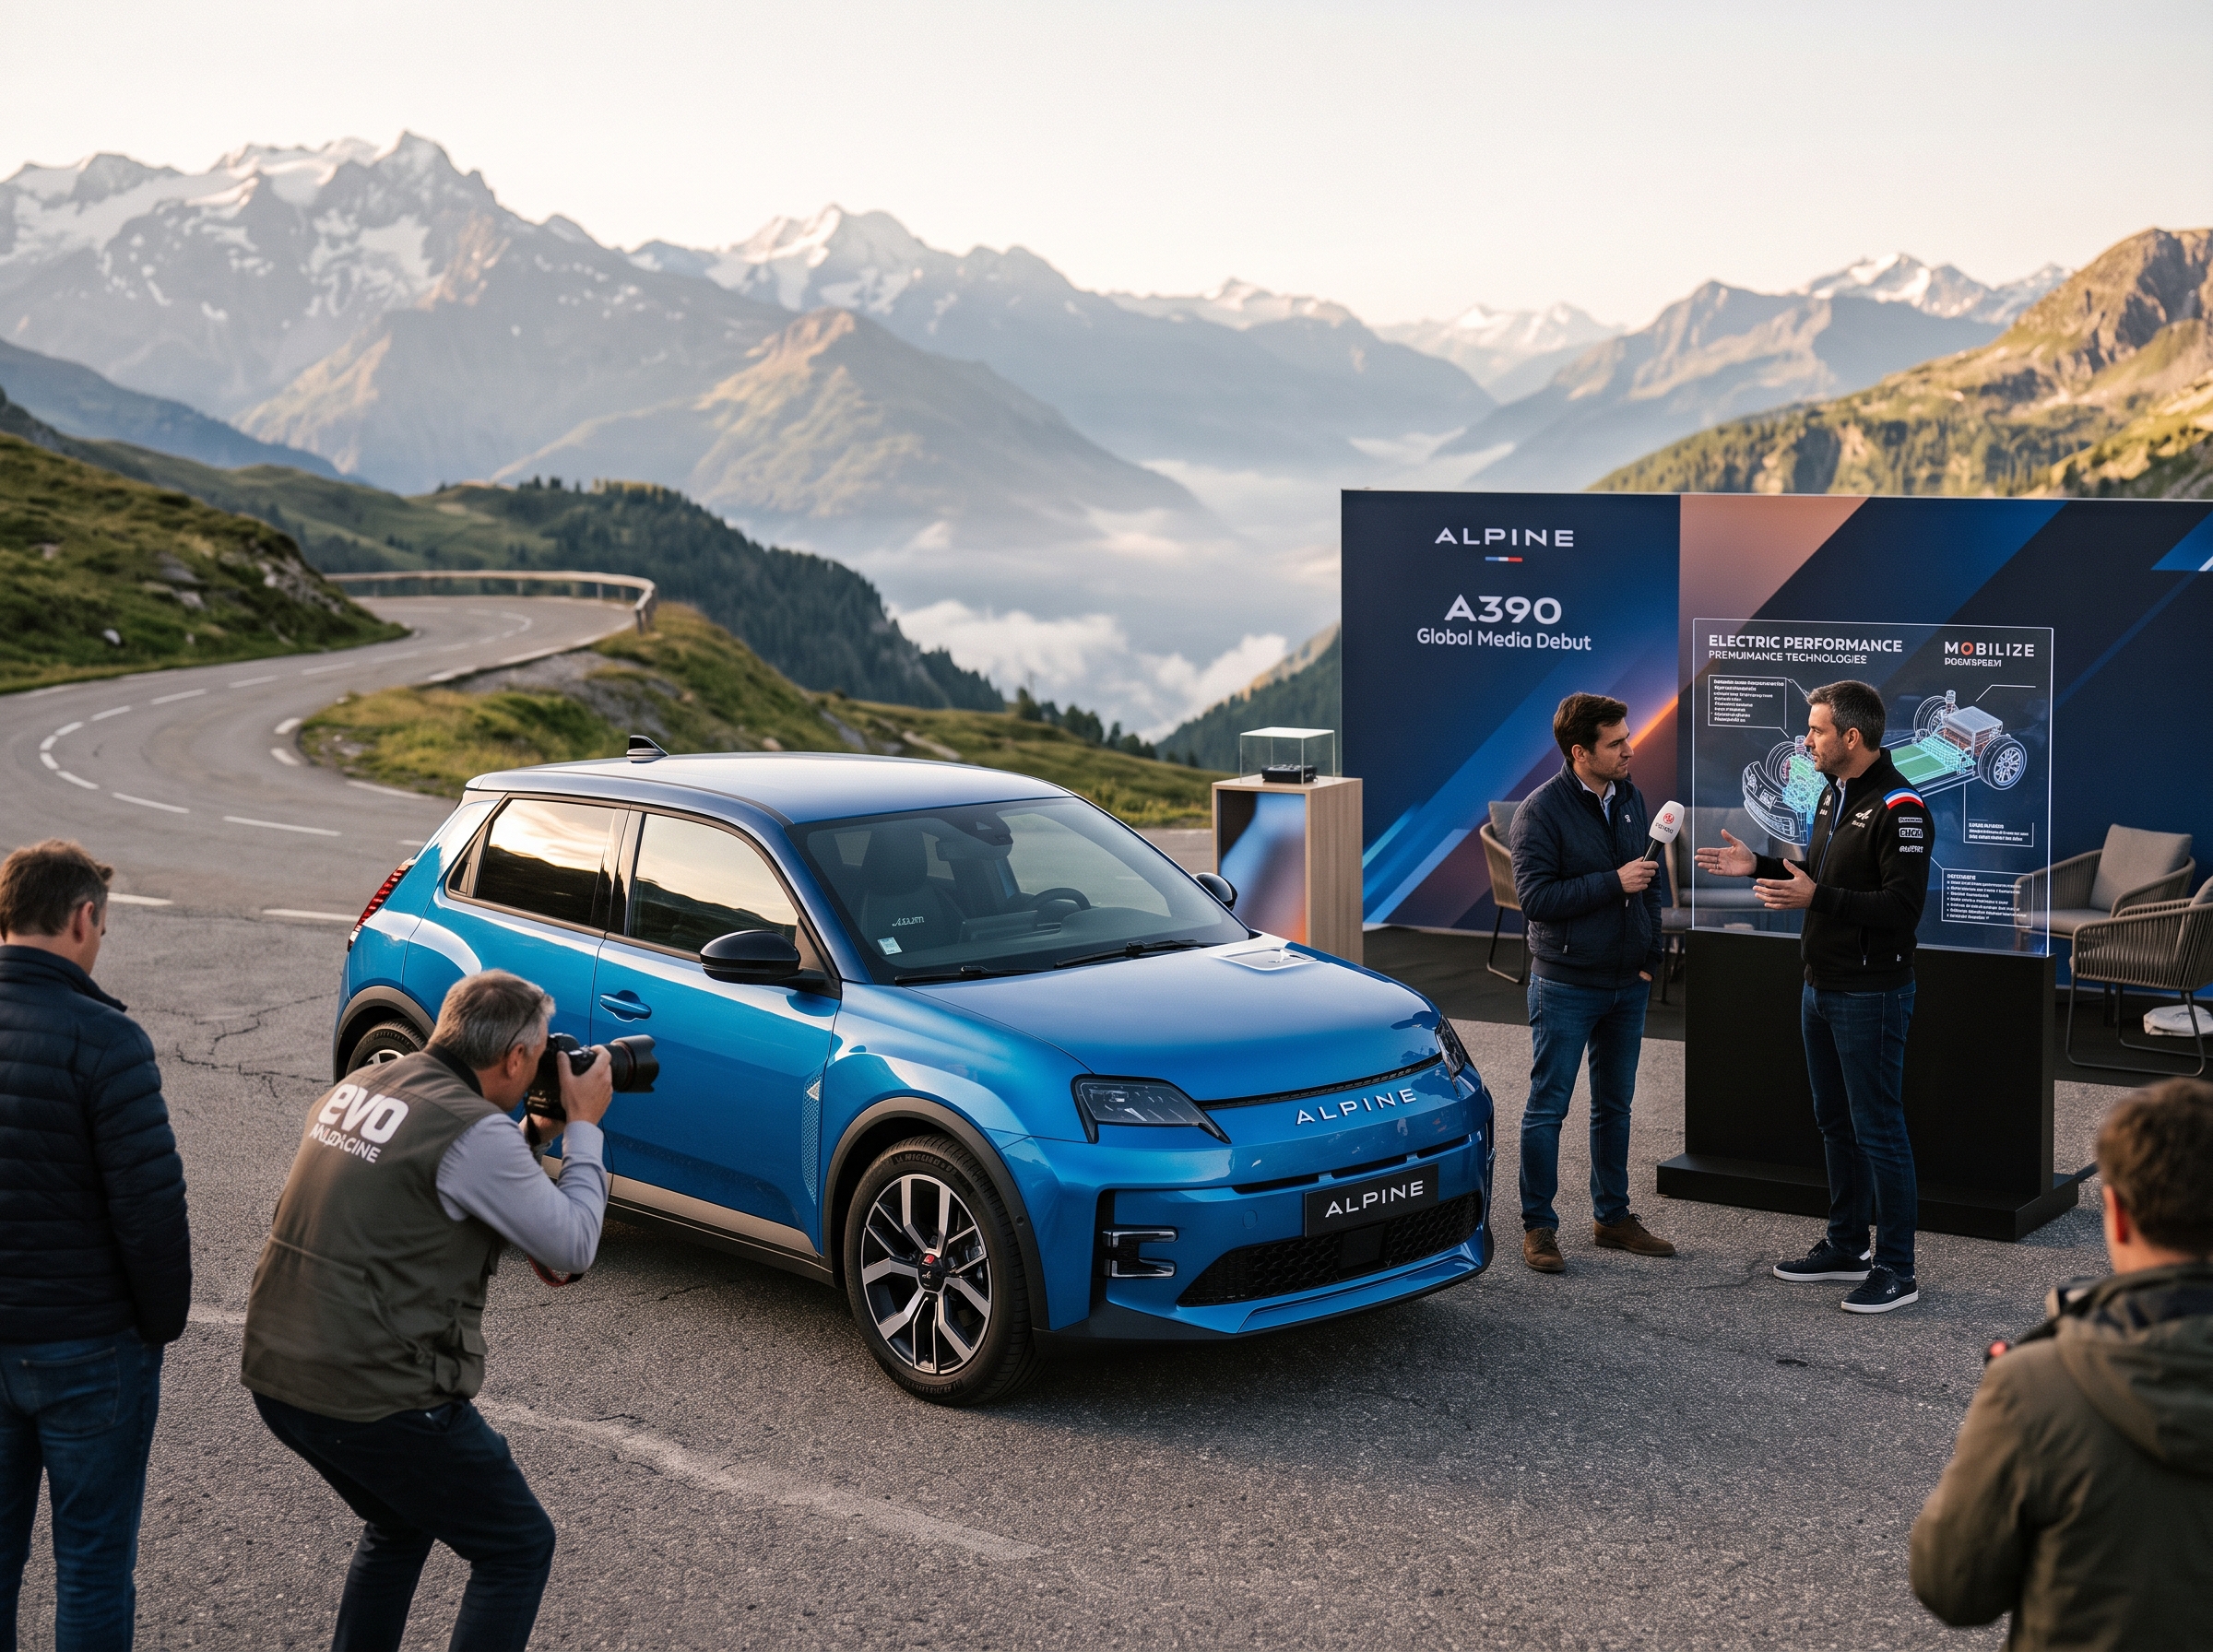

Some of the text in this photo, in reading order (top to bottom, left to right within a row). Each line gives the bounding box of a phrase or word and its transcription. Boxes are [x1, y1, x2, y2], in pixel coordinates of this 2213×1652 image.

[1435, 527, 1573, 547] ALPINE
[1445, 595, 1561, 624] A390
[1417, 628, 1592, 651] Global Media Debut
[1709, 634, 1903, 653] ELECTRIC PERFORMANCE
[1944, 641, 2035, 657] MOBILIZE
[318, 1083, 409, 1144] evo
[1296, 1088, 1417, 1126] ALPINE
[1325, 1180, 1424, 1218] ALPINE
